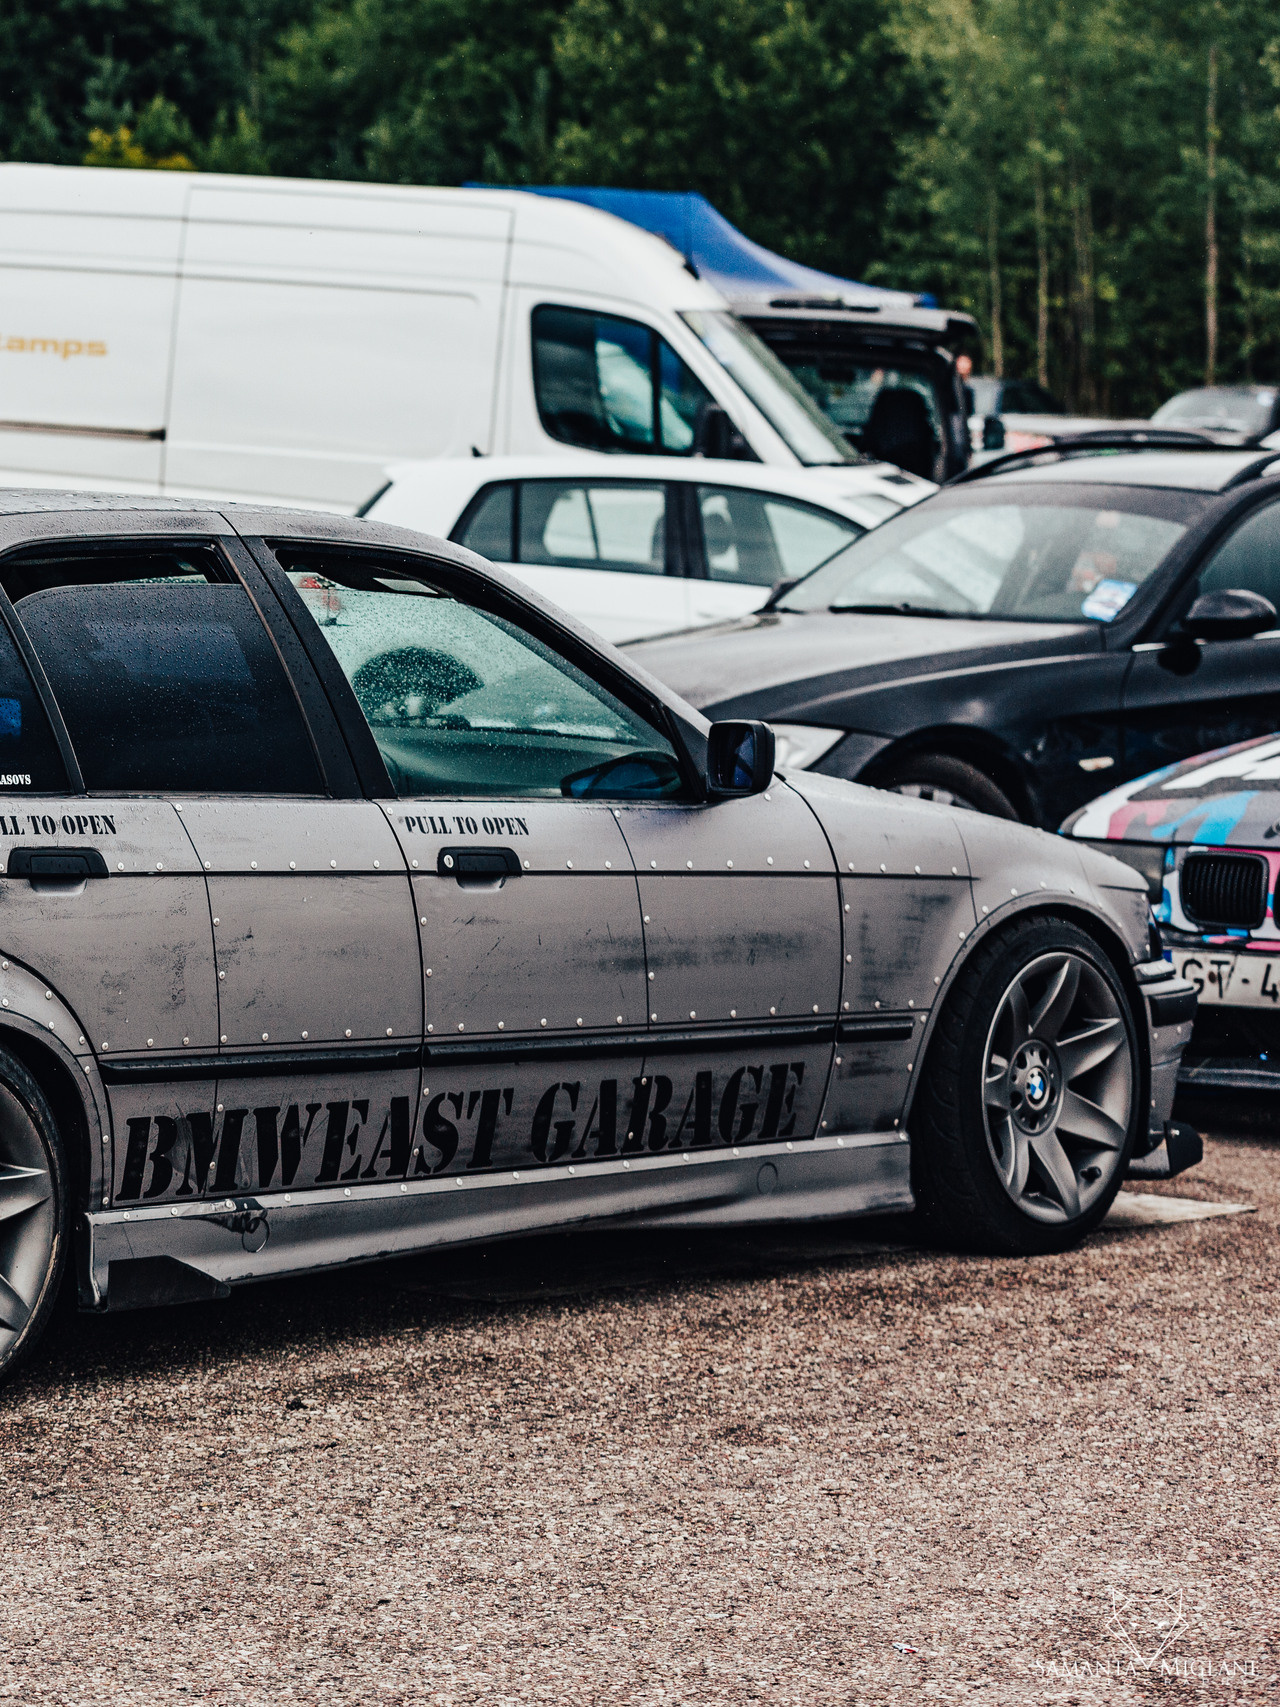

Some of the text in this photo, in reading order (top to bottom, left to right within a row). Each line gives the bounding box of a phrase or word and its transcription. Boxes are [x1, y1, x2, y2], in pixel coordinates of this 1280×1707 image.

[27, 815, 57, 835] TO
[61, 815, 117, 835] OPEN
[405, 816, 529, 836] PULL TO OPEN
[115, 1061, 805, 1200] BMWEAST GARAGE
